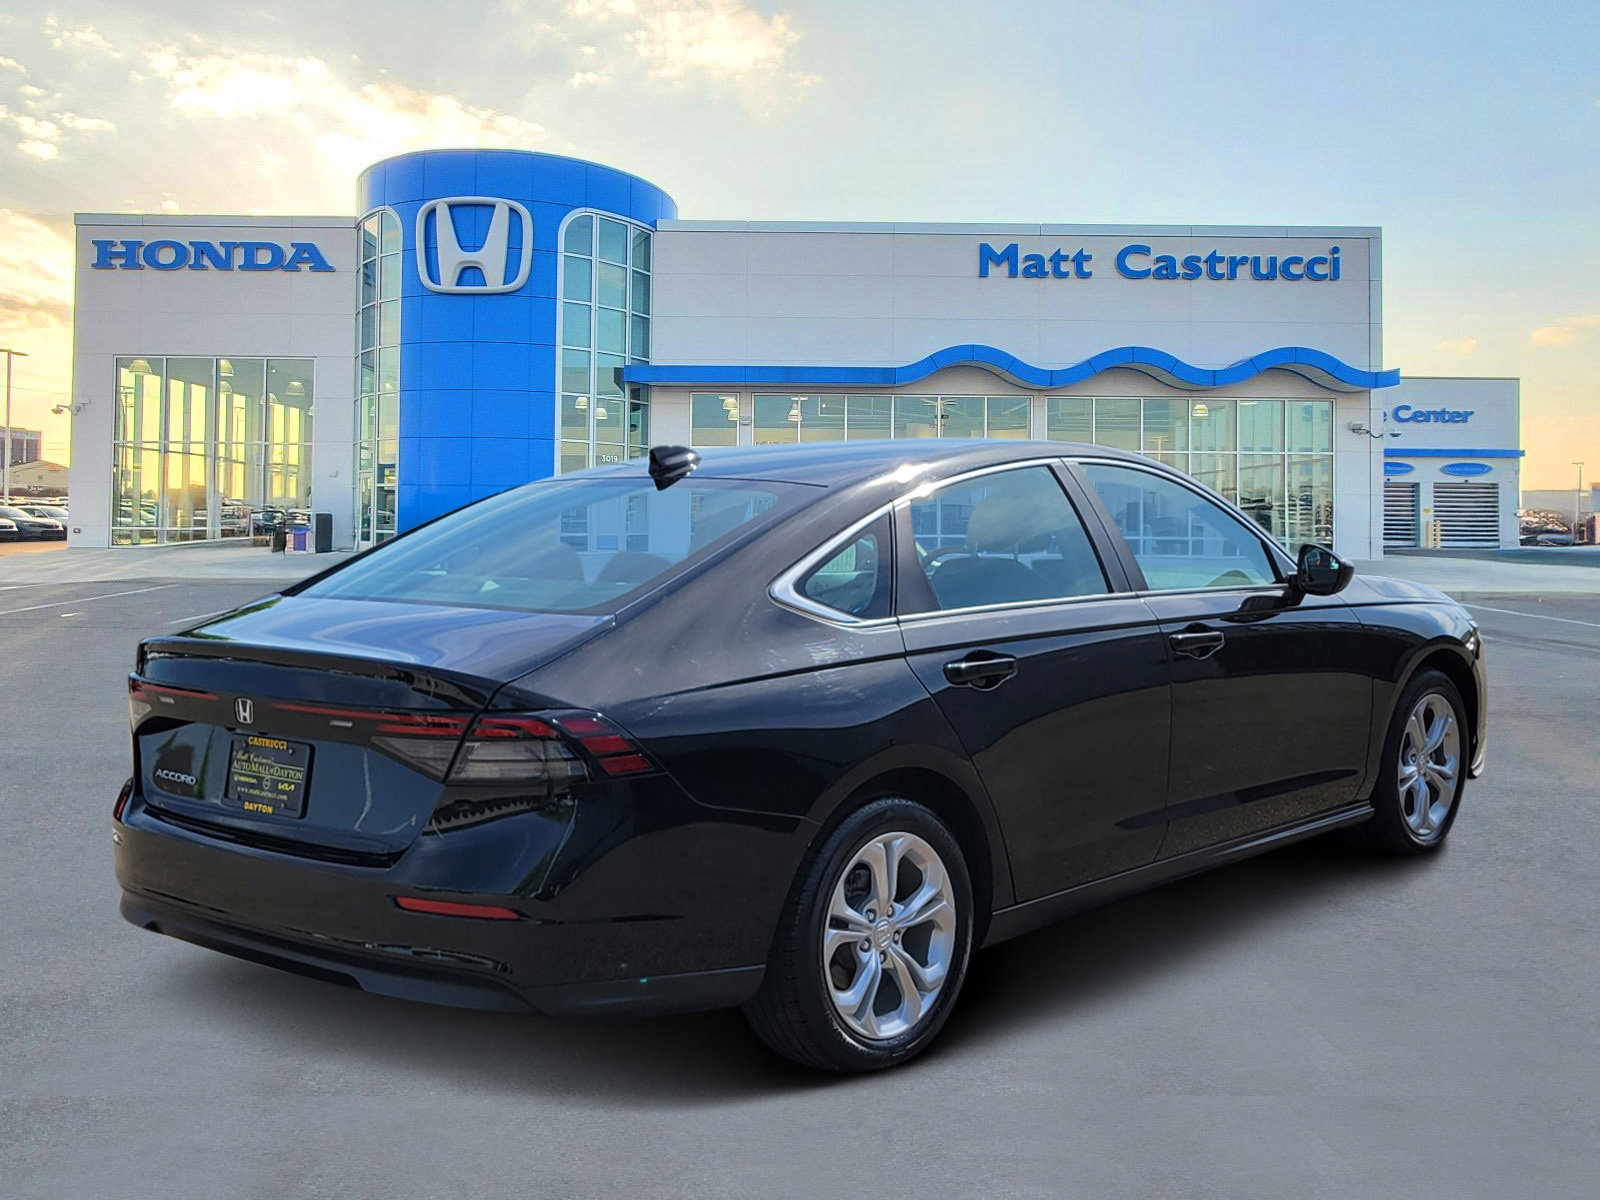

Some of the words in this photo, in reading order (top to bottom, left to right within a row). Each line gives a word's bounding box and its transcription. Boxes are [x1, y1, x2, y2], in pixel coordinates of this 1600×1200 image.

[91, 239, 336, 272] HONDA
[978, 242, 1093, 278] Matt
[1114, 244, 1342, 281] Castrucci
[1391, 404, 1475, 424] Center
[601, 454, 618, 463] 3019
[247, 736, 287, 751] CASTRUCCI
[155, 768, 197, 786] ACCORD
[244, 801, 273, 814] DAYTON
